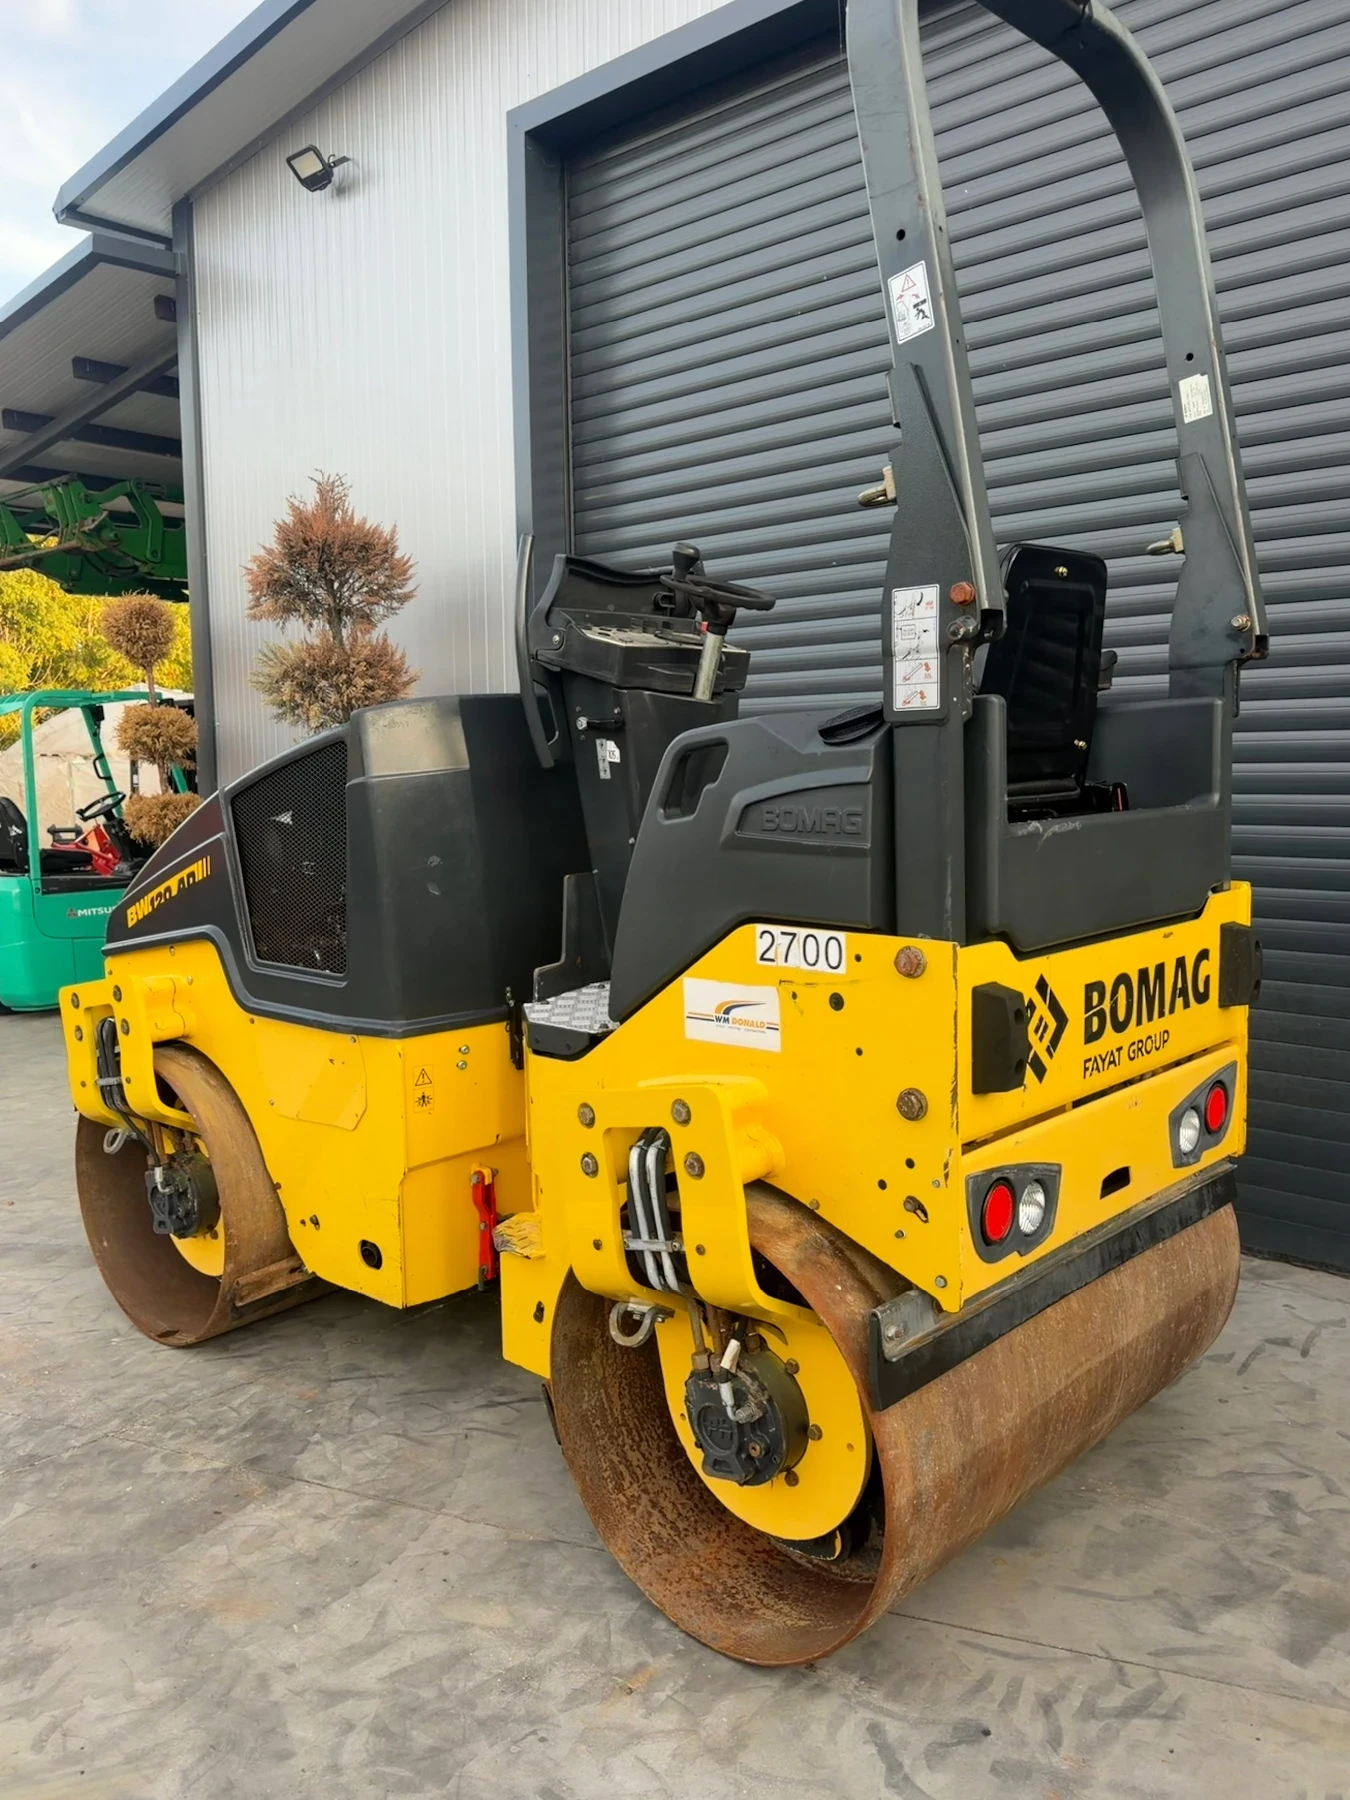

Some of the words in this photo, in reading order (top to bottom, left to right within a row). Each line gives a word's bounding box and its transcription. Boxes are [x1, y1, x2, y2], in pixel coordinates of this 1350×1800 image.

[761, 805, 863, 835] BOMAG
[77, 905, 115, 917] MITSU
[759, 930, 843, 970] 2700
[1084, 948, 1210, 1045] BOMAG
[714, 1015, 730, 1024] WM
[731, 1017, 766, 1029] DONALD
[1083, 1046, 1123, 1080] FAYAT
[1127, 1029, 1170, 1062] GROUP
